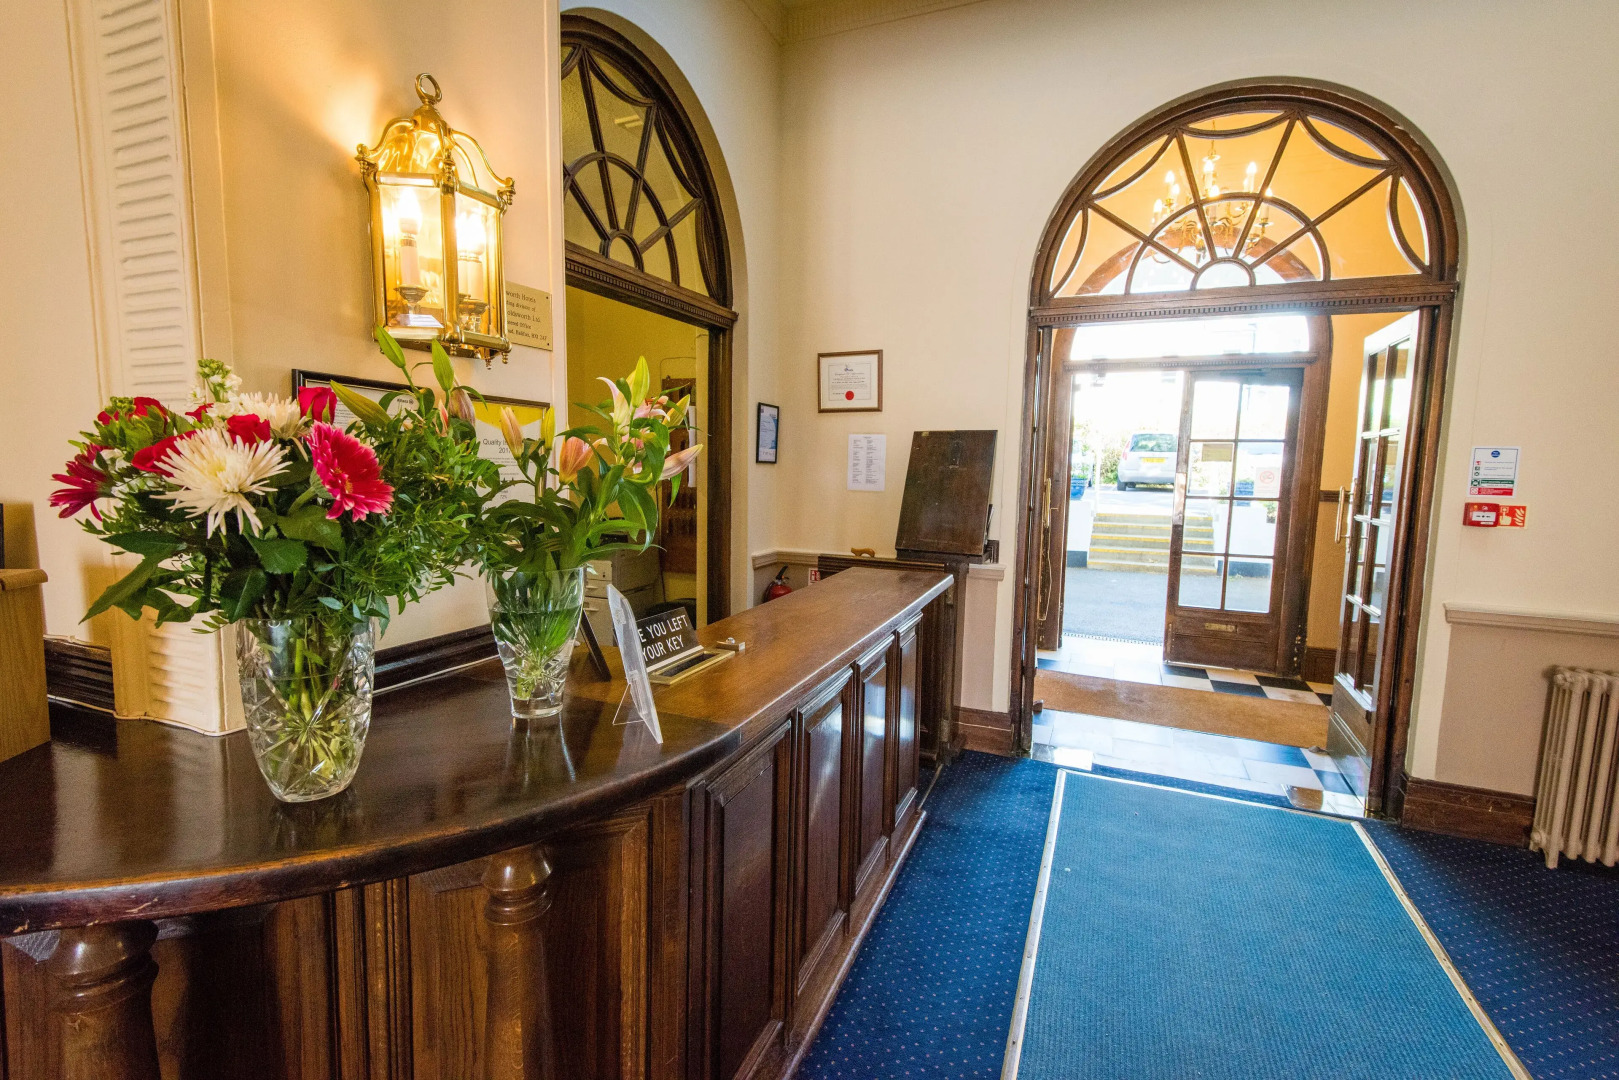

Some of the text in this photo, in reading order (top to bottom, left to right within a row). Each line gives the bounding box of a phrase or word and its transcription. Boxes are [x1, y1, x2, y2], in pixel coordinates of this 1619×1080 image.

[645, 621, 667, 639] YOU
[666, 614, 688, 633] LEFT
[642, 634, 684, 662] YOUR KEY
